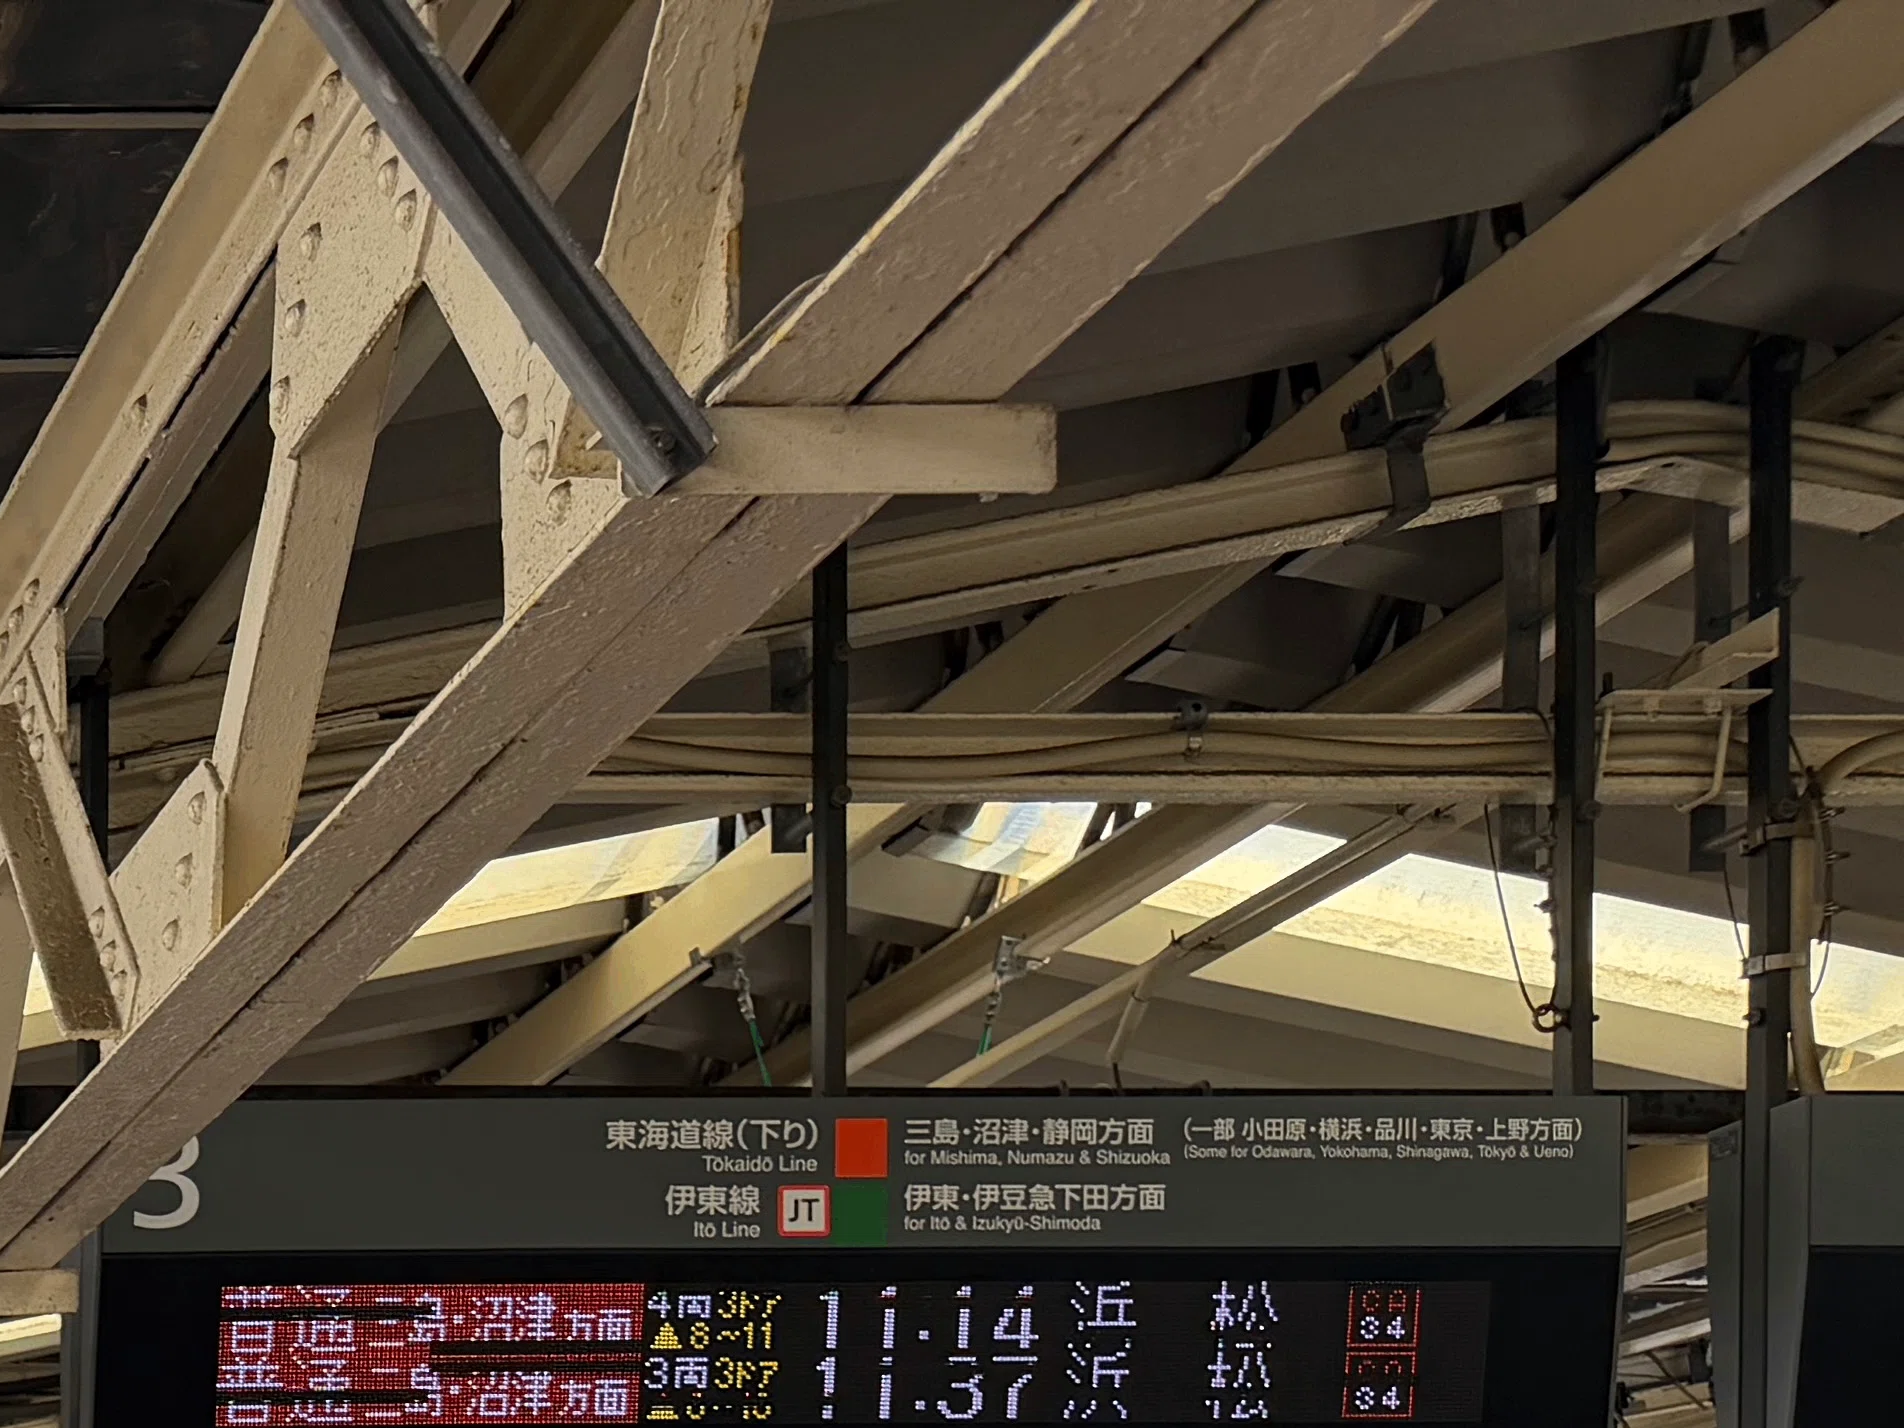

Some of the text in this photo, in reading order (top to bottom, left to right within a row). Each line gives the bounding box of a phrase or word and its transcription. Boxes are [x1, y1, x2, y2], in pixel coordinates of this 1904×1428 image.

[605, 1118, 819, 1151] 東海道線(下り)
[904, 1118, 1154, 1145] 三島・沼津・静岡方面
[779, 1155, 818, 1172] Line
[904, 1150, 1172, 1167] for Mishima, Numazu & Shizuoka
[1183, 1144, 1227, 1159] (Some
[1231, 1144, 1248, 1158] for
[1251, 1144, 1316, 1160] Odawara,
[1320, 1144, 1392, 1160] Yokohama,
[1396, 1144, 1474, 1162] Shinagawa,
[1519, 1145, 1530, 1159] &
[1533, 1144, 1575, 1160] Ueno)
[665, 1184, 761, 1216] 伊東線
[904, 1184, 1166, 1212] 伊東・伊豆急下田方面
[788, 1198, 820, 1222] JT
[722, 1221, 761, 1238] Line
[904, 1216, 926, 1231] for
[954, 1216, 967, 1231] &
